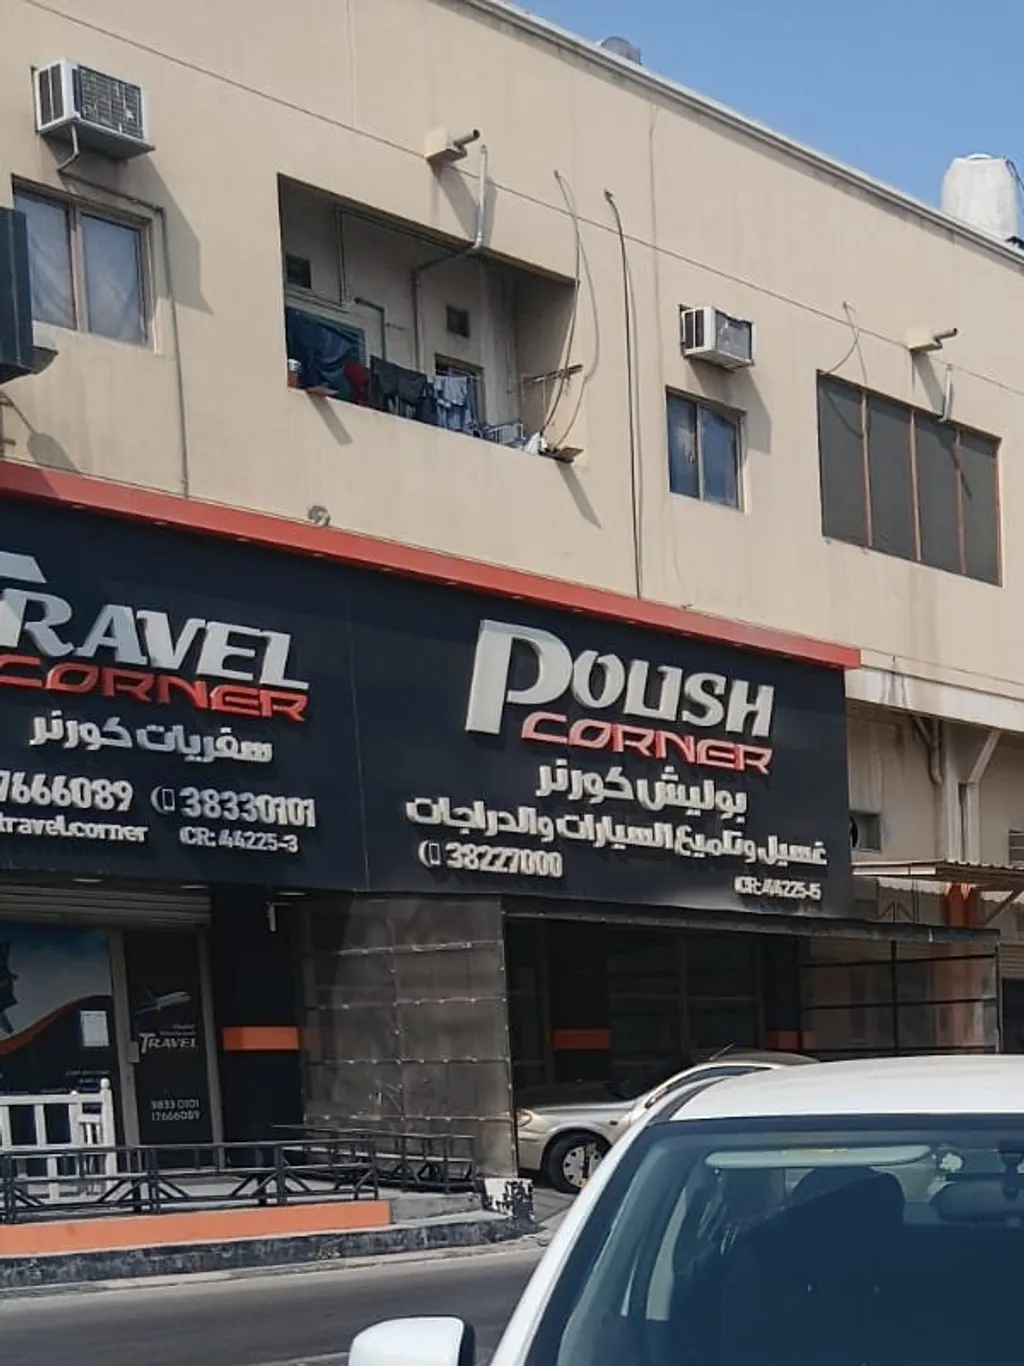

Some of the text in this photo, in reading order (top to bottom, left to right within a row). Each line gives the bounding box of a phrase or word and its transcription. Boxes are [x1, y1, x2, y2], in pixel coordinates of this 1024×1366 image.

[0, 654, 309, 721] CORNER
[465, 619, 775, 738] POLISH
[29, 710, 273, 763] سفريات كورنر
[520, 711, 774, 775] CORNER
[179, 786, 316, 828] 38330101
[535, 758, 748, 823] بوليش كورنر
[406, 797, 828, 866] غسيل وتلميع السيارات والدراجات
[445, 842, 563, 878] 38227000
[139, 1032, 197, 1054] TRAVEL
